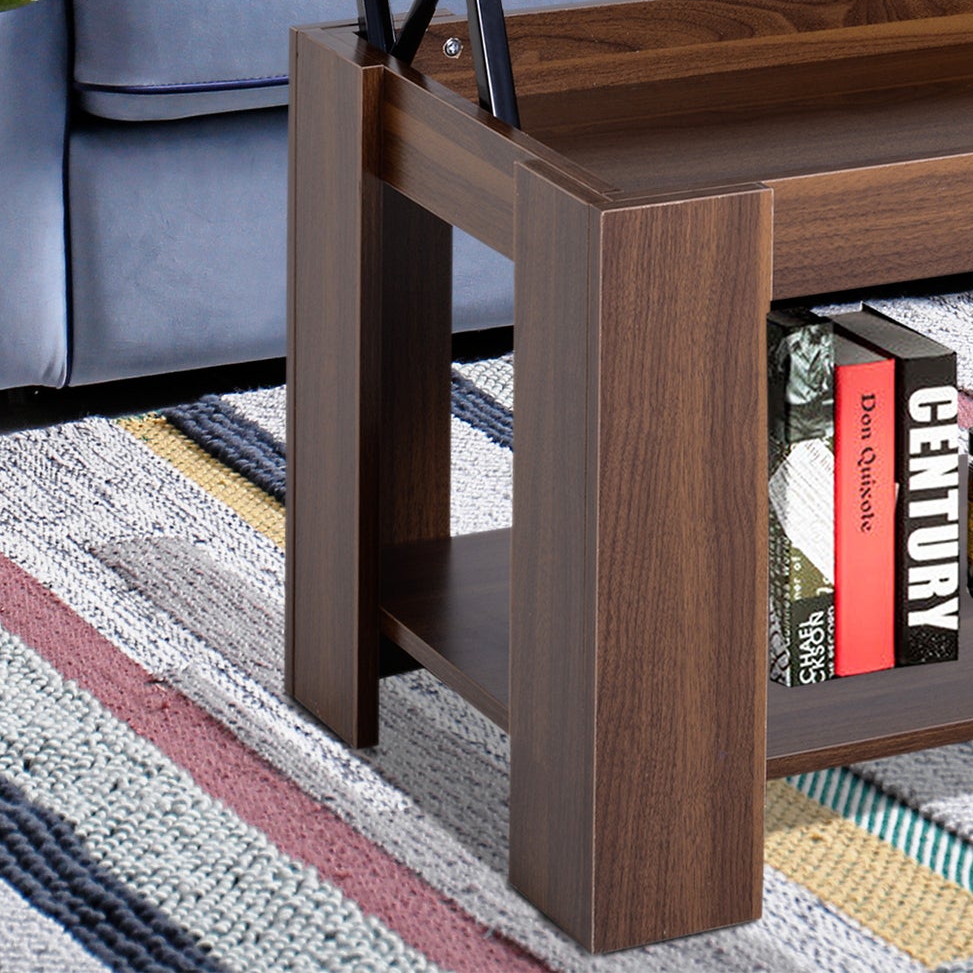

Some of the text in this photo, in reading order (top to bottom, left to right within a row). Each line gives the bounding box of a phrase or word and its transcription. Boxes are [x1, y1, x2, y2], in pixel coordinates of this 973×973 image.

[857, 393, 877, 533] Don Quixote
[907, 385, 960, 631] CENTURY
